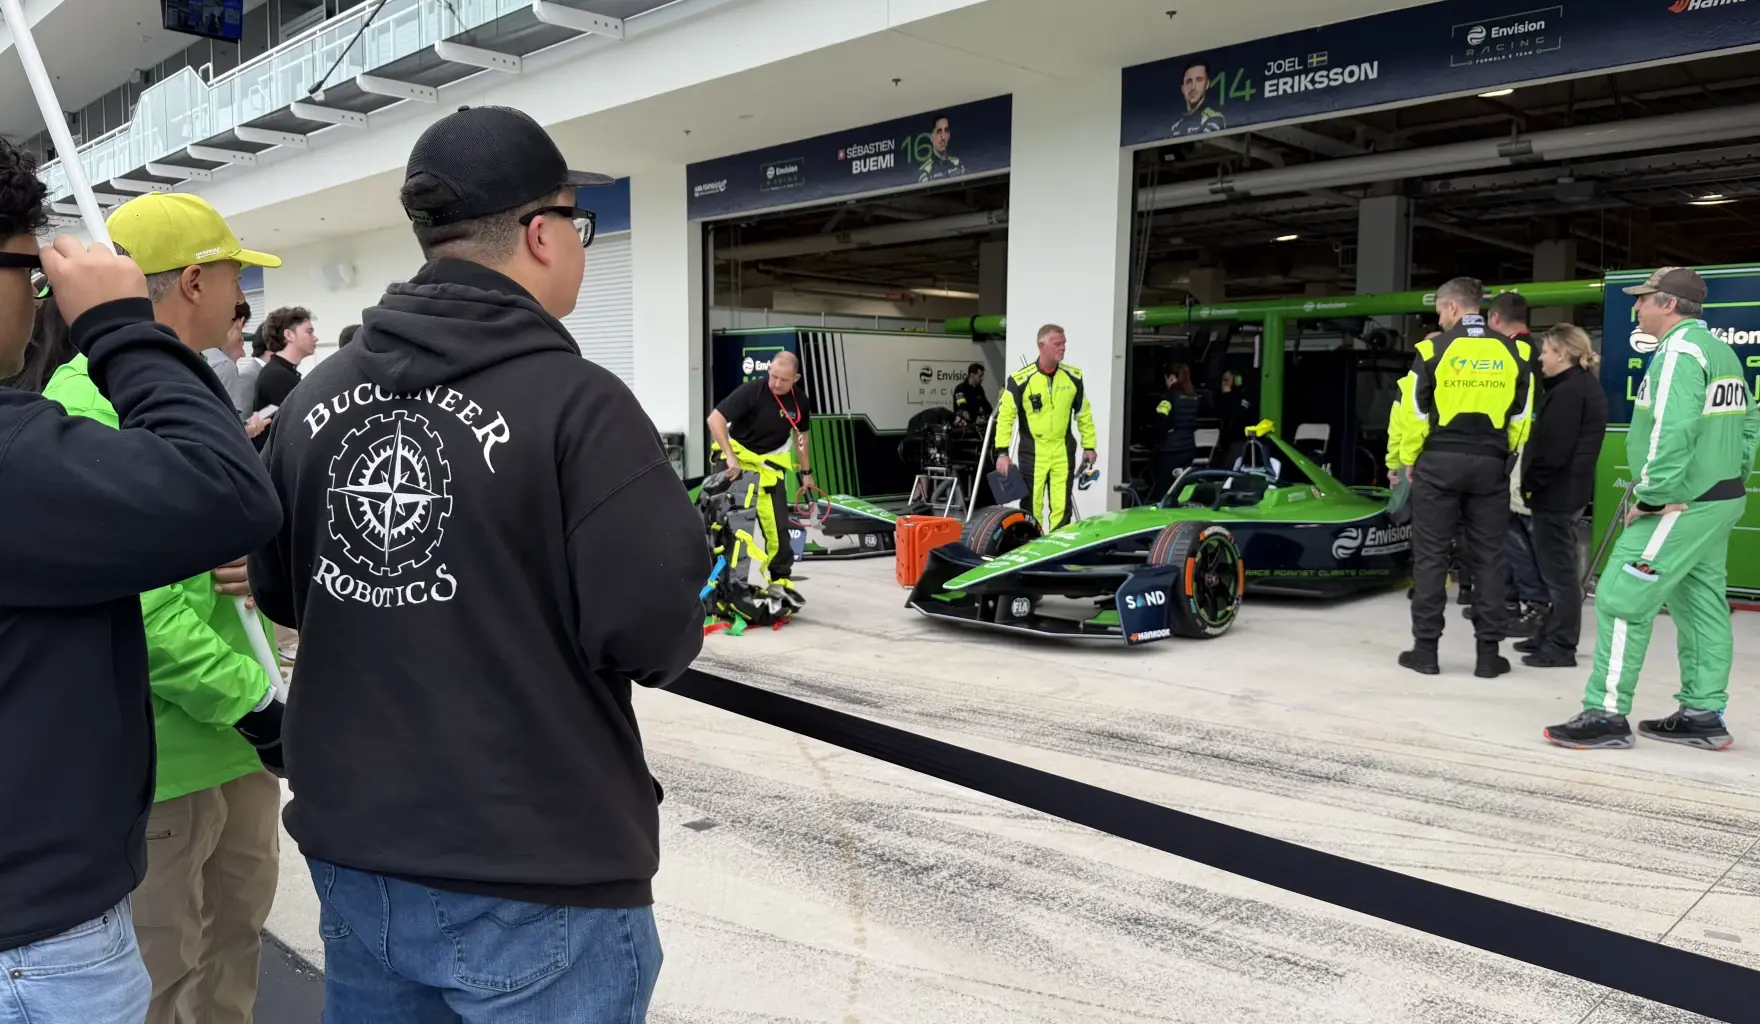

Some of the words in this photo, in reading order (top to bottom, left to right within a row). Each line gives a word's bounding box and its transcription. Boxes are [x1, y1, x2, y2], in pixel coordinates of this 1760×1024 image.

[1491, 20, 1545, 38] Envision
[1466, 36, 1545, 56] RACING
[1265, 57, 1303, 76] JOEL
[1210, 68, 1256, 106] 14
[1264, 61, 1379, 98] ERIKSSON
[846, 139, 895, 158] SÉBASTIEN
[901, 133, 932, 164] 16
[852, 153, 895, 175] BUEMI
[936, 369, 968, 381] Envisio
[1443, 379, 1506, 389] EXTRICATION
[303, 383, 510, 474] BUCCNEER
[313, 555, 458, 608] ROBOTICS
